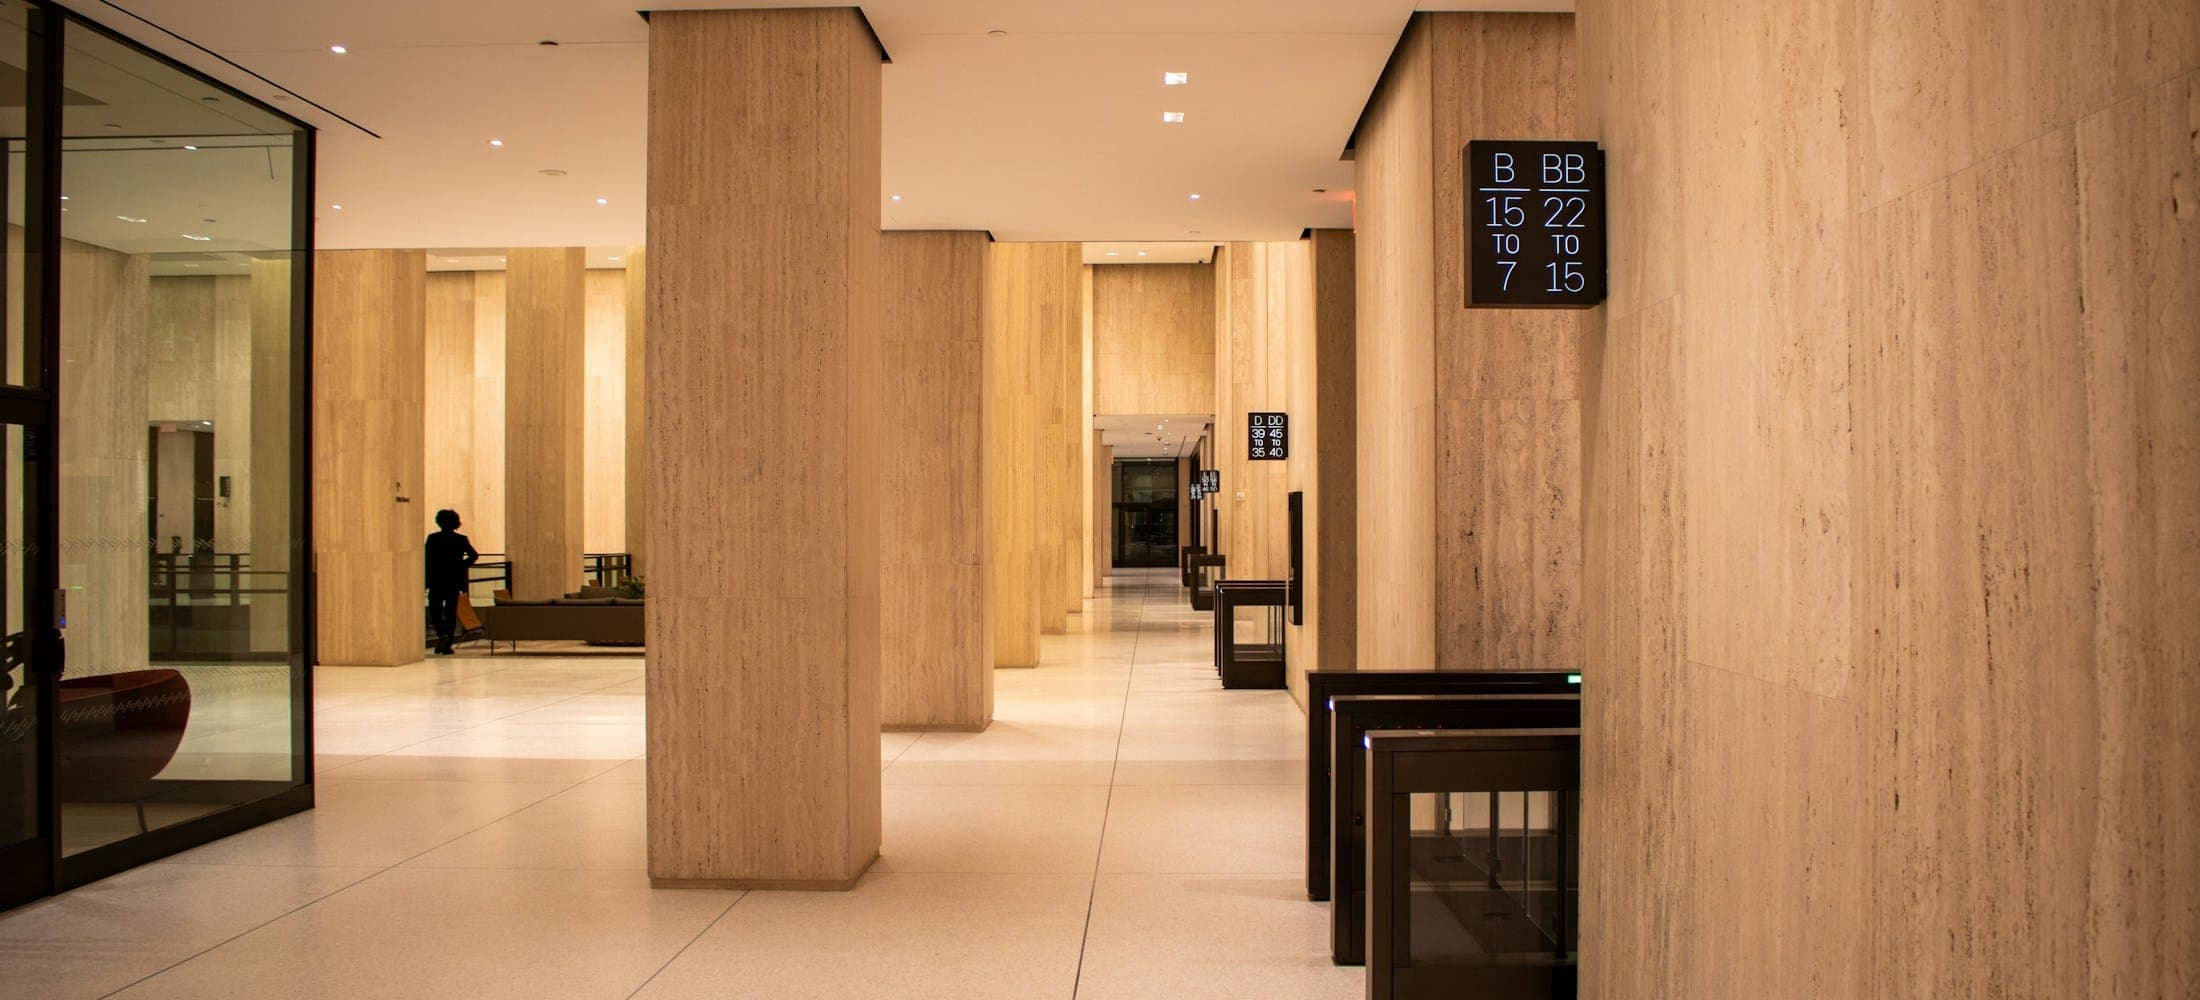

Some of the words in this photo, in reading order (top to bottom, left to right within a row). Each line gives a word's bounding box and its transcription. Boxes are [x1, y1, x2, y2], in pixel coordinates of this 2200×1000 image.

[1494, 152, 1515, 183] B
[1543, 153, 1586, 184] BB
[1486, 196, 1525, 227] 15
[1544, 197, 1586, 228] 22
[1492, 233, 1520, 255] TO
[1551, 234, 1580, 255] TO
[1496, 261, 1517, 291] 7
[1546, 262, 1585, 292] 15
[1254, 415, 1263, 426] D
[1268, 415, 1284, 426] DD
[1251, 428, 1266, 439] 39
[1269, 428, 1283, 439] 45
[1251, 447, 1266, 458] 35
[1269, 447, 1284, 458] 40
